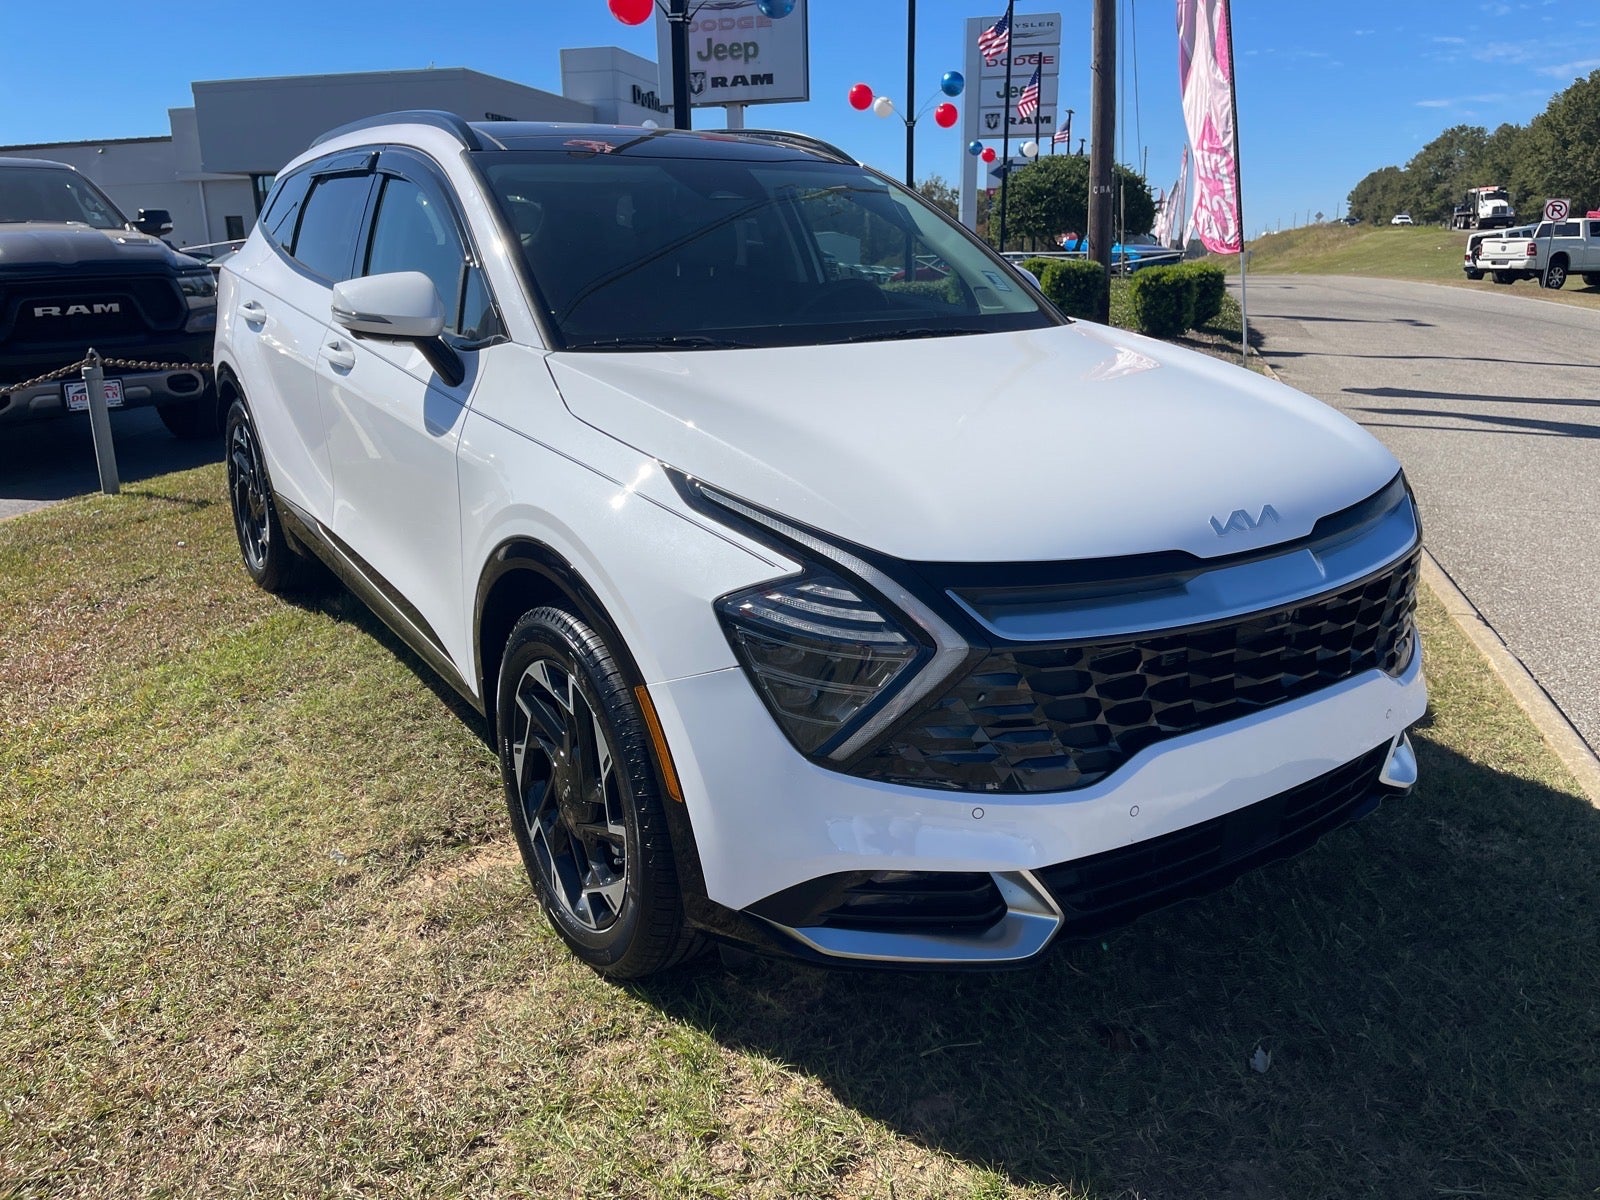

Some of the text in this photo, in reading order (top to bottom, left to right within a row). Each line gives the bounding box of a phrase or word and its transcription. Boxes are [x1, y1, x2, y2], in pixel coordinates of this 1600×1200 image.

[697, 37, 760, 64] Jeep
[710, 72, 774, 89] RAM
[34, 303, 120, 317] RAM
